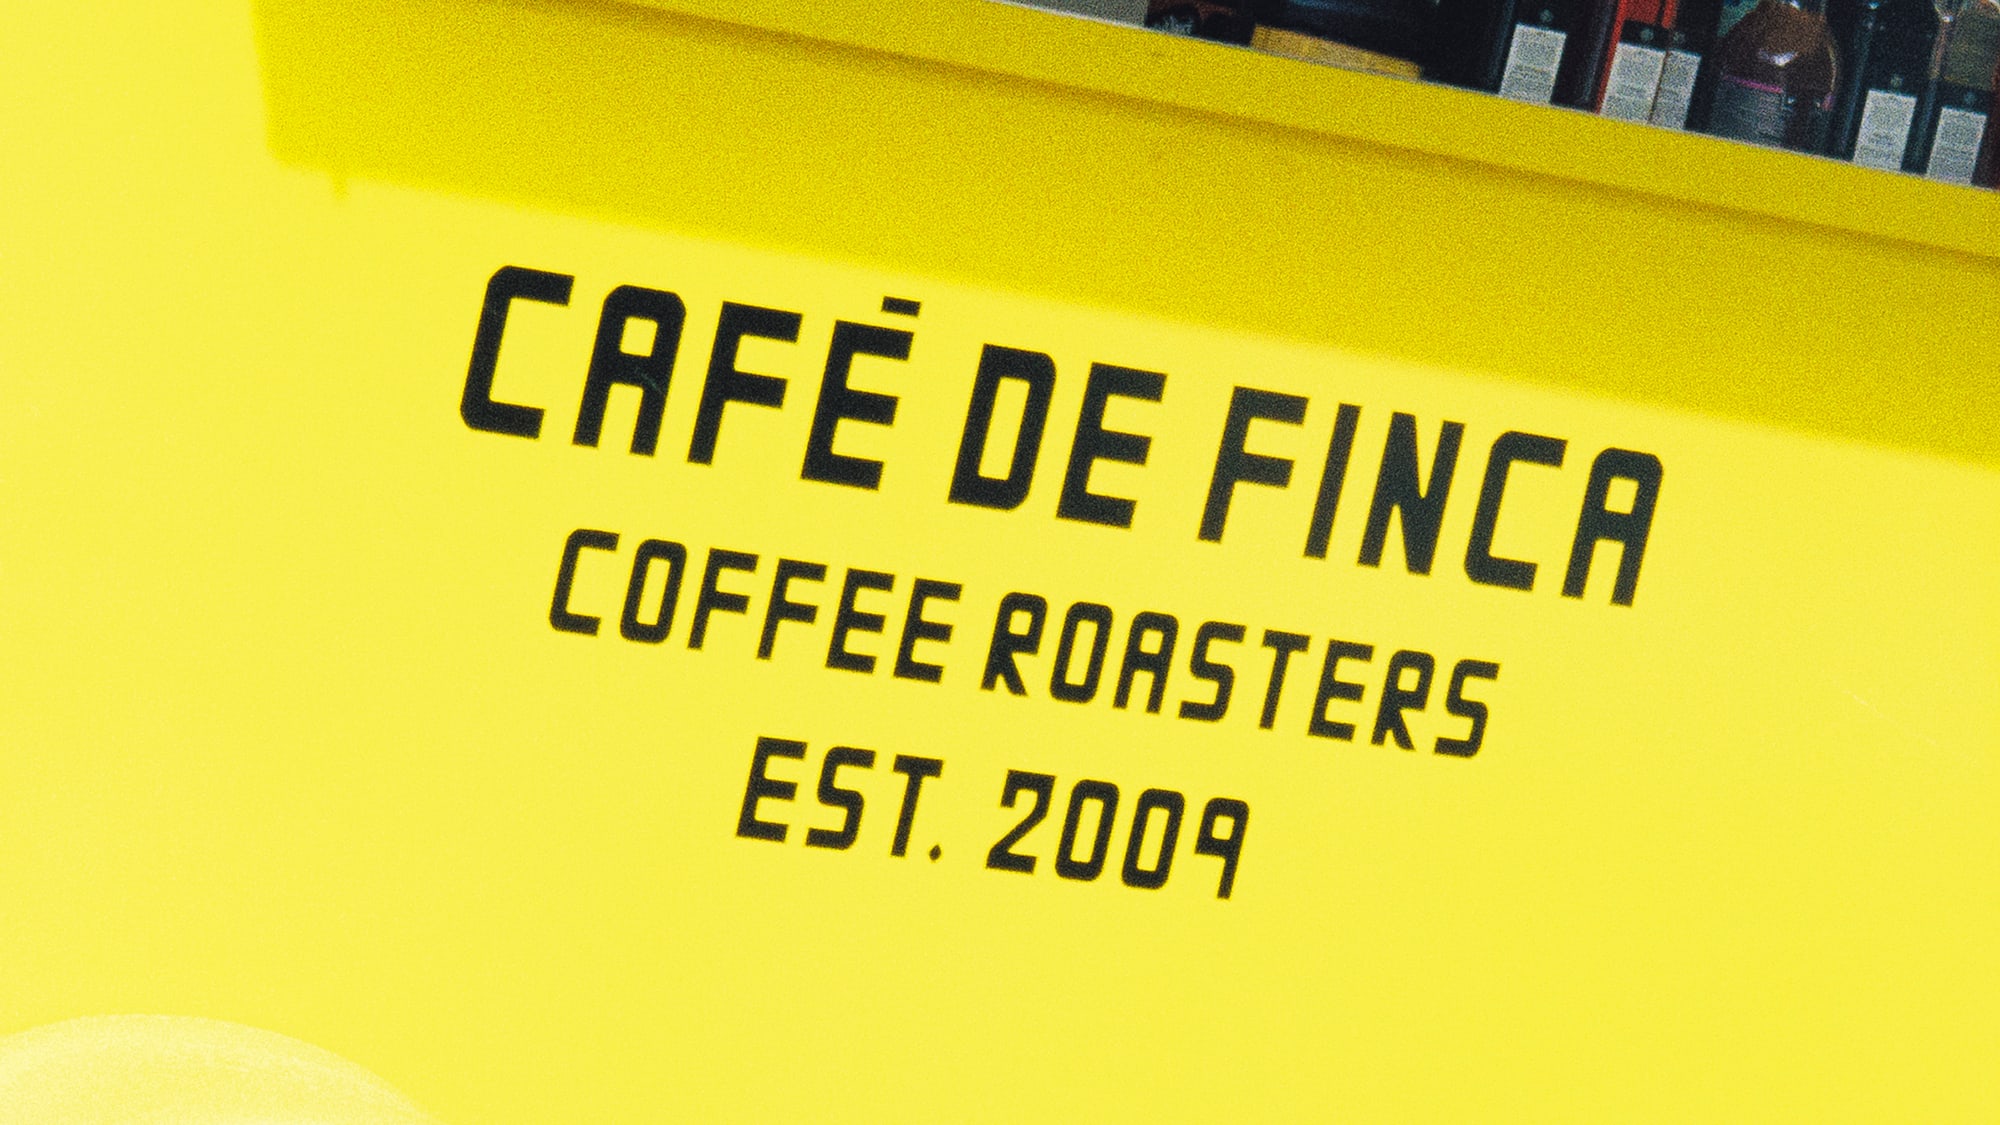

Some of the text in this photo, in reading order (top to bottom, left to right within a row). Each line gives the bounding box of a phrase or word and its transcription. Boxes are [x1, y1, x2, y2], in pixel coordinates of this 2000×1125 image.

[459, 264, 1664, 607] CAFÉ DE FINCA
[548, 528, 1499, 759] COFFEE ROASTERS
[736, 736, 1250, 900] EST. 2009
